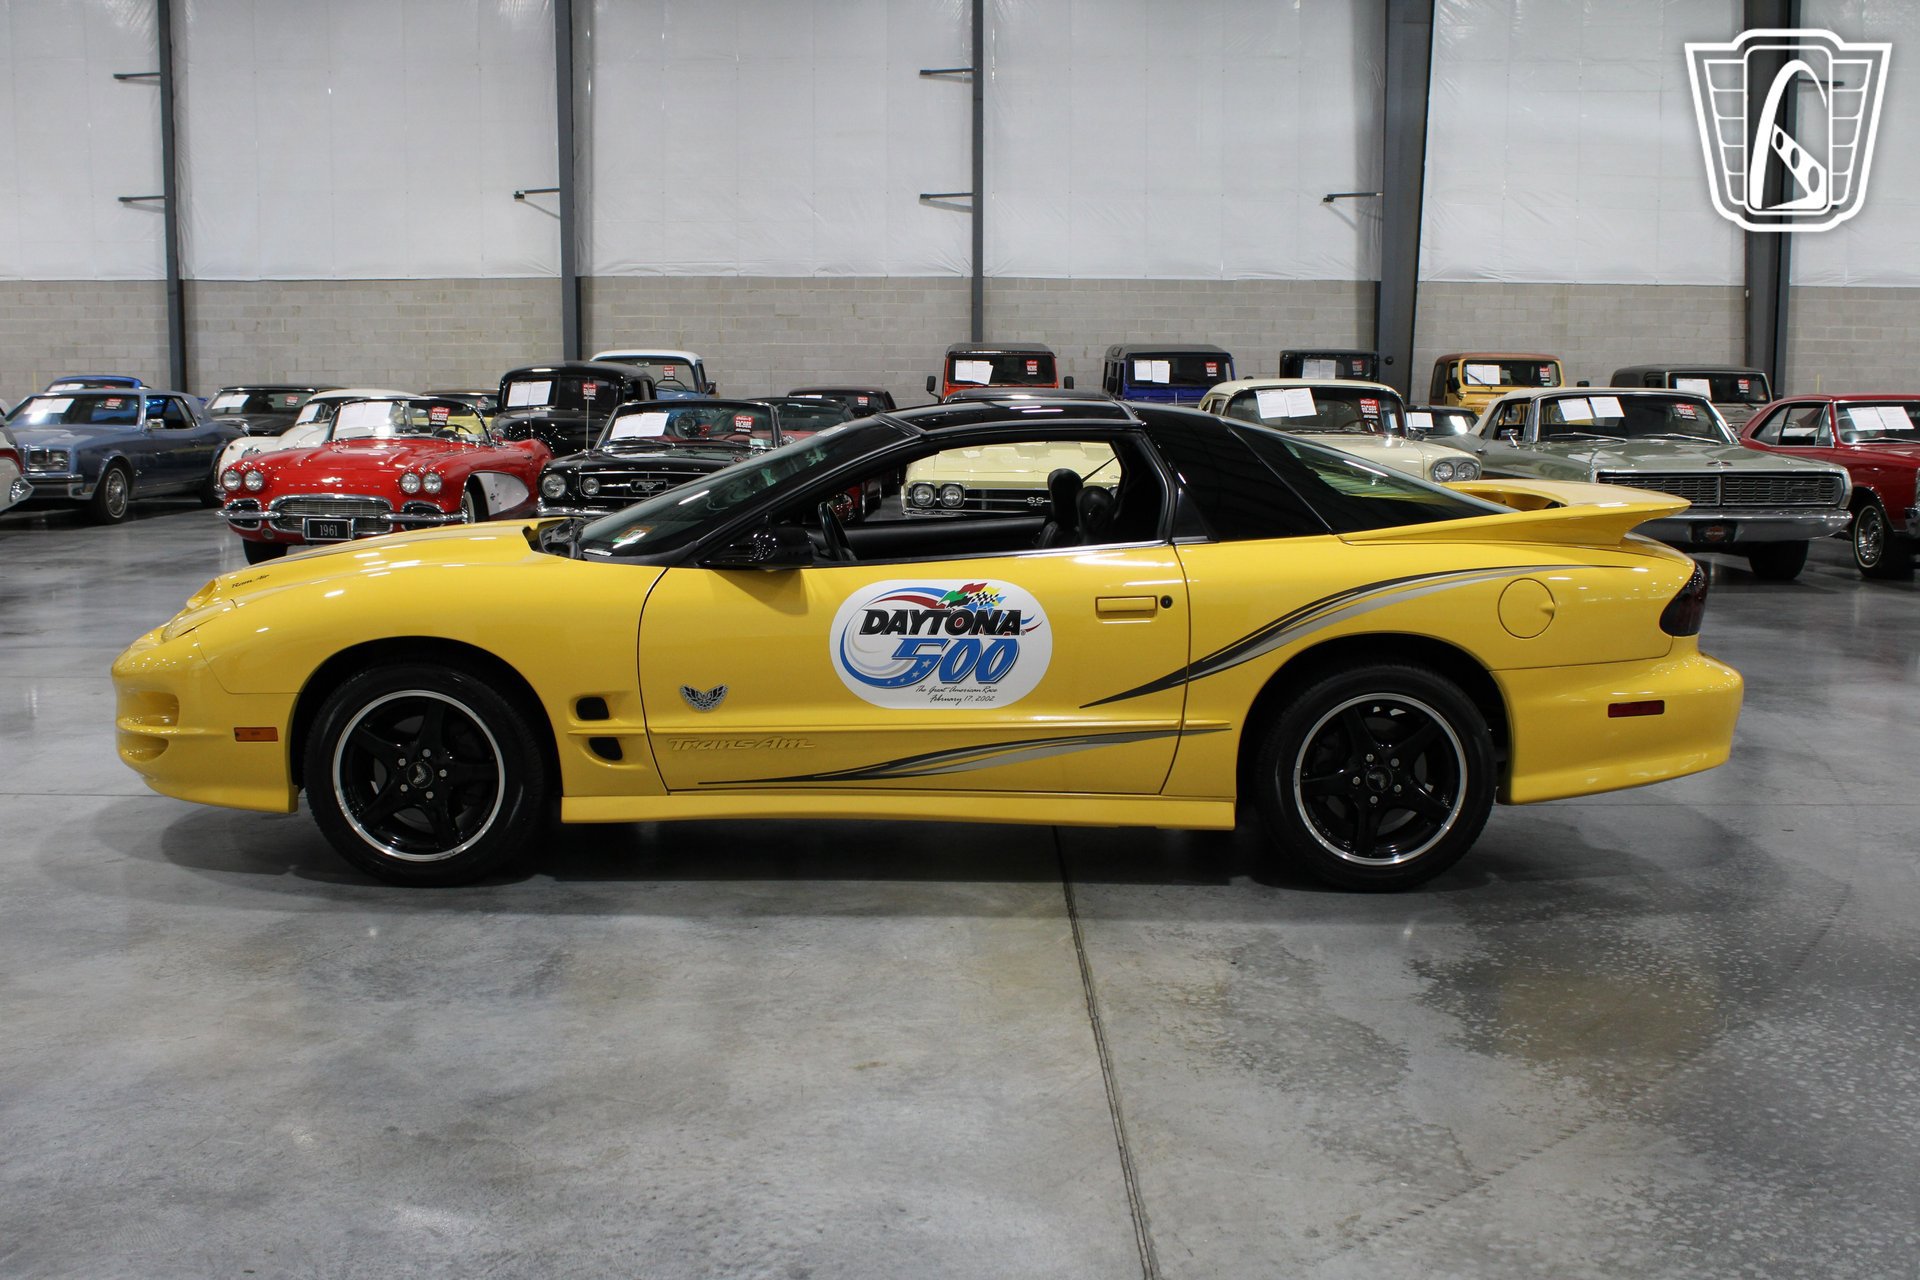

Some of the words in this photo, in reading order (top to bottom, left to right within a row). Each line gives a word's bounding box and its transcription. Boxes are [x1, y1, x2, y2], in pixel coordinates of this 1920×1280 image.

[320, 524, 338, 537] 1961
[859, 609, 1021, 636] DAYTONA
[928, 686, 946, 695] Great
[930, 694, 962, 706] February
